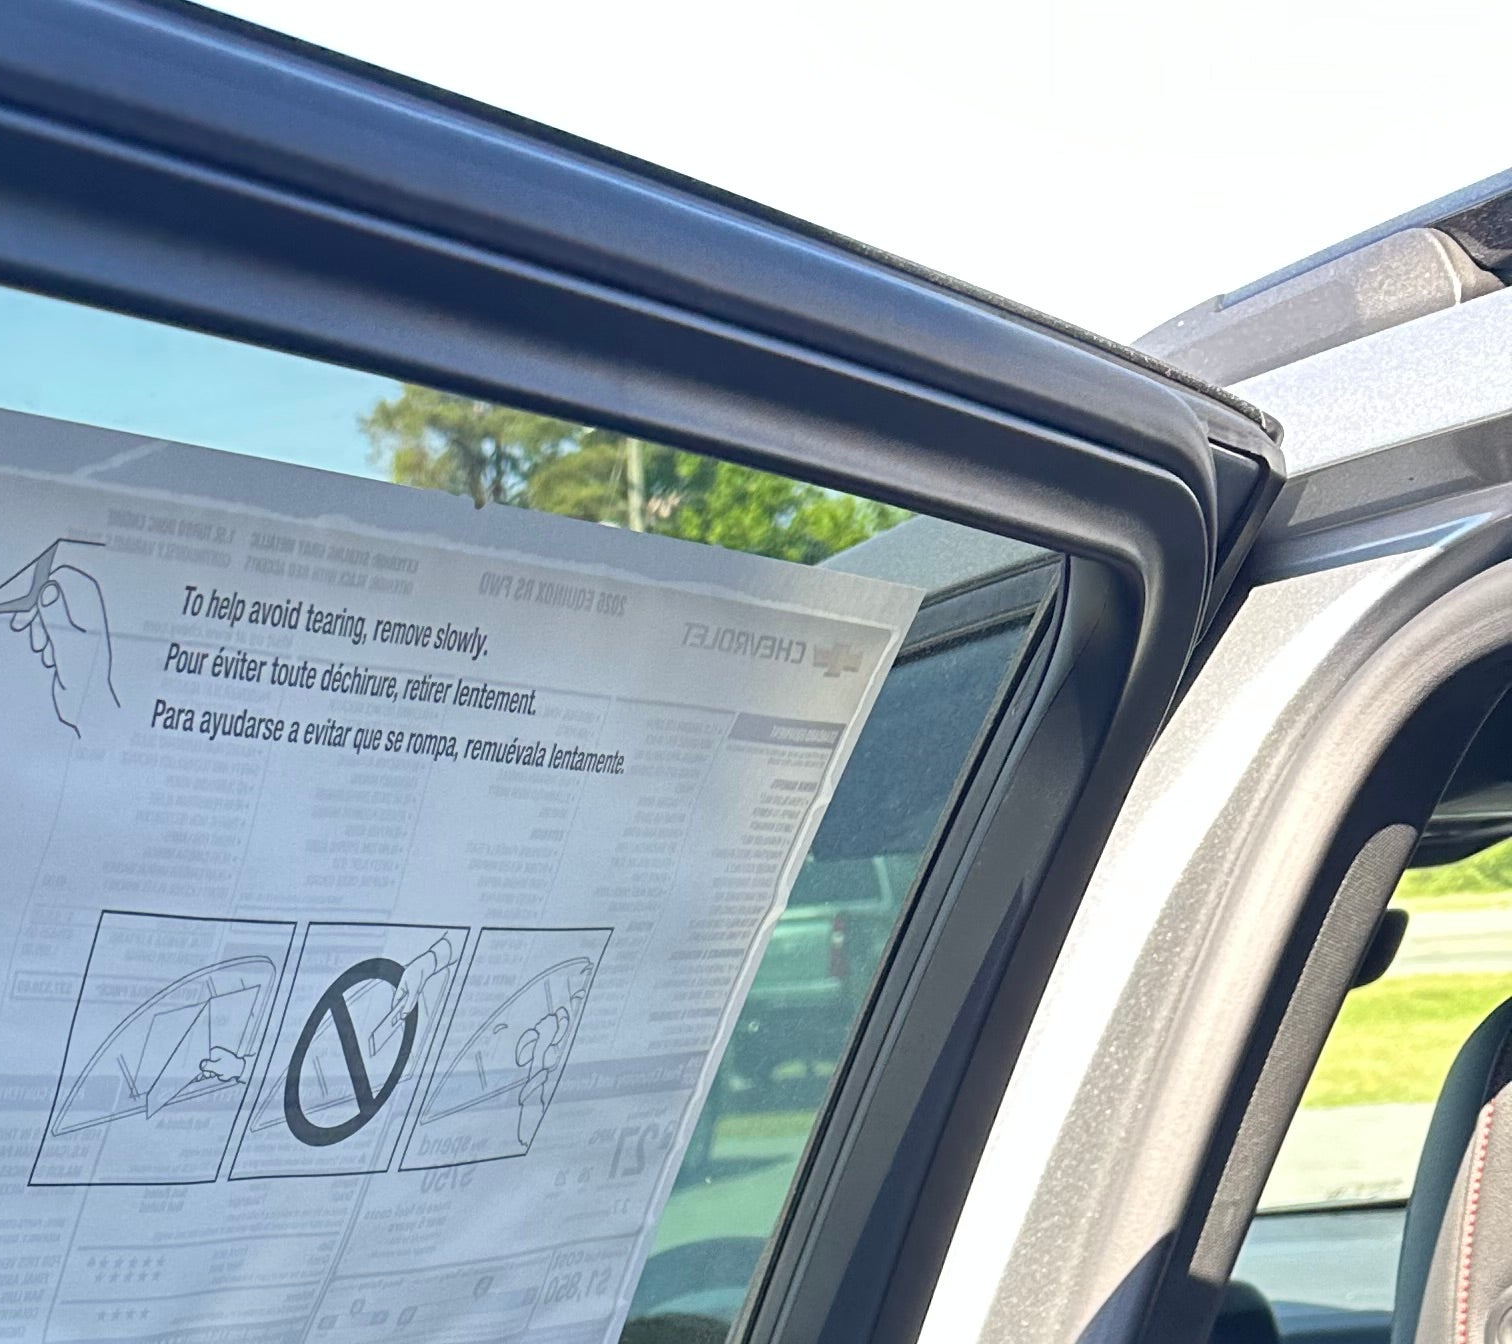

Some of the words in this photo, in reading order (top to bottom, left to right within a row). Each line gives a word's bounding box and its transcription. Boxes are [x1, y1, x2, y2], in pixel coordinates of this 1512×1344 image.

[183, 585, 204, 617] To
[206, 589, 244, 624] help
[249, 597, 301, 630] avoid
[305, 604, 368, 645] tearing,
[374, 619, 431, 648] remove
[434, 623, 488, 660] slowly.
[163, 643, 209, 675] Pour
[212, 648, 268, 683] éviter
[271, 657, 315, 689] toute
[321, 661, 398, 700] déchirure,
[403, 674, 453, 704] retirer
[453, 678, 537, 716] lentement.
[150, 699, 194, 731] Para
[200, 704, 282, 742] ayudarse
[287, 719, 301, 741] a
[304, 715, 351, 745] evitar
[353, 727, 382, 752] que
[386, 730, 403, 752] se
[406, 732, 458, 762] rompa,
[464, 732, 545, 768] remuévala
[547, 741, 625, 775] lentamente.
